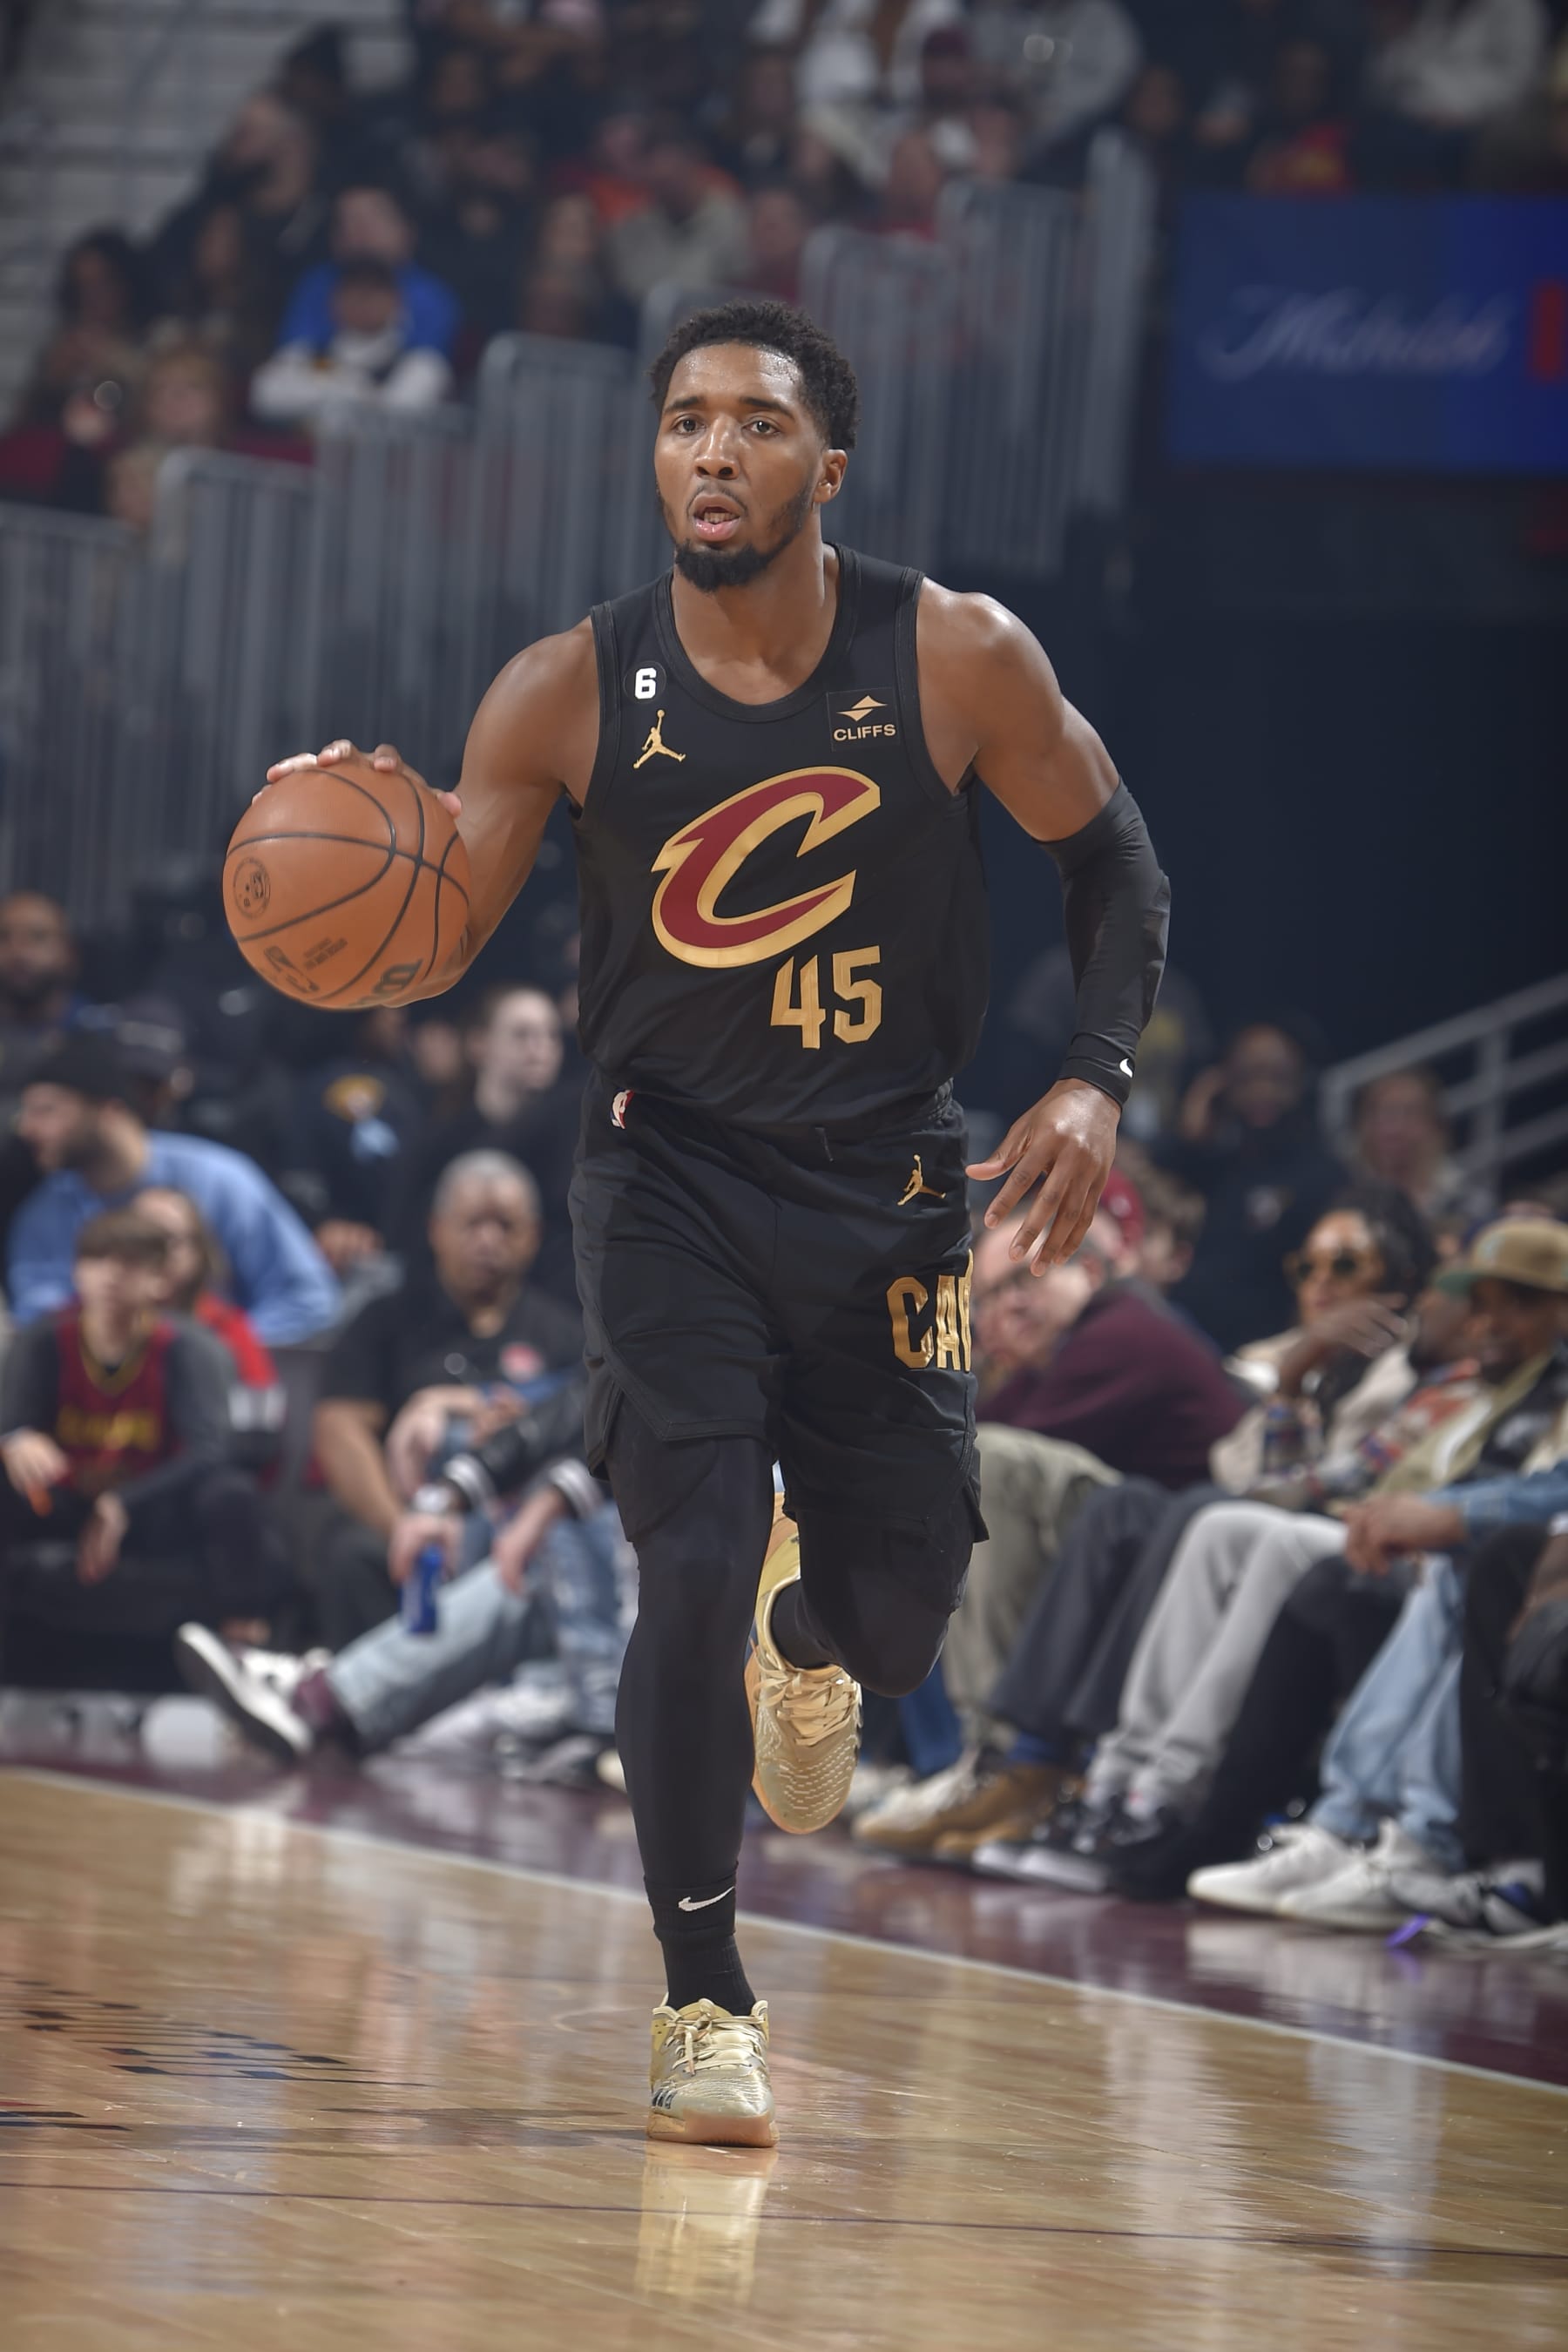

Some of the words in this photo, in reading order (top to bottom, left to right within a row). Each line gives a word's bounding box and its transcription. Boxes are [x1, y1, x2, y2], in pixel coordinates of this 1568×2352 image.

[634, 667, 657, 700] 6
[833, 723, 896, 742] CLIFFS
[651, 766, 881, 969] C
[770, 945, 882, 1050] 45
